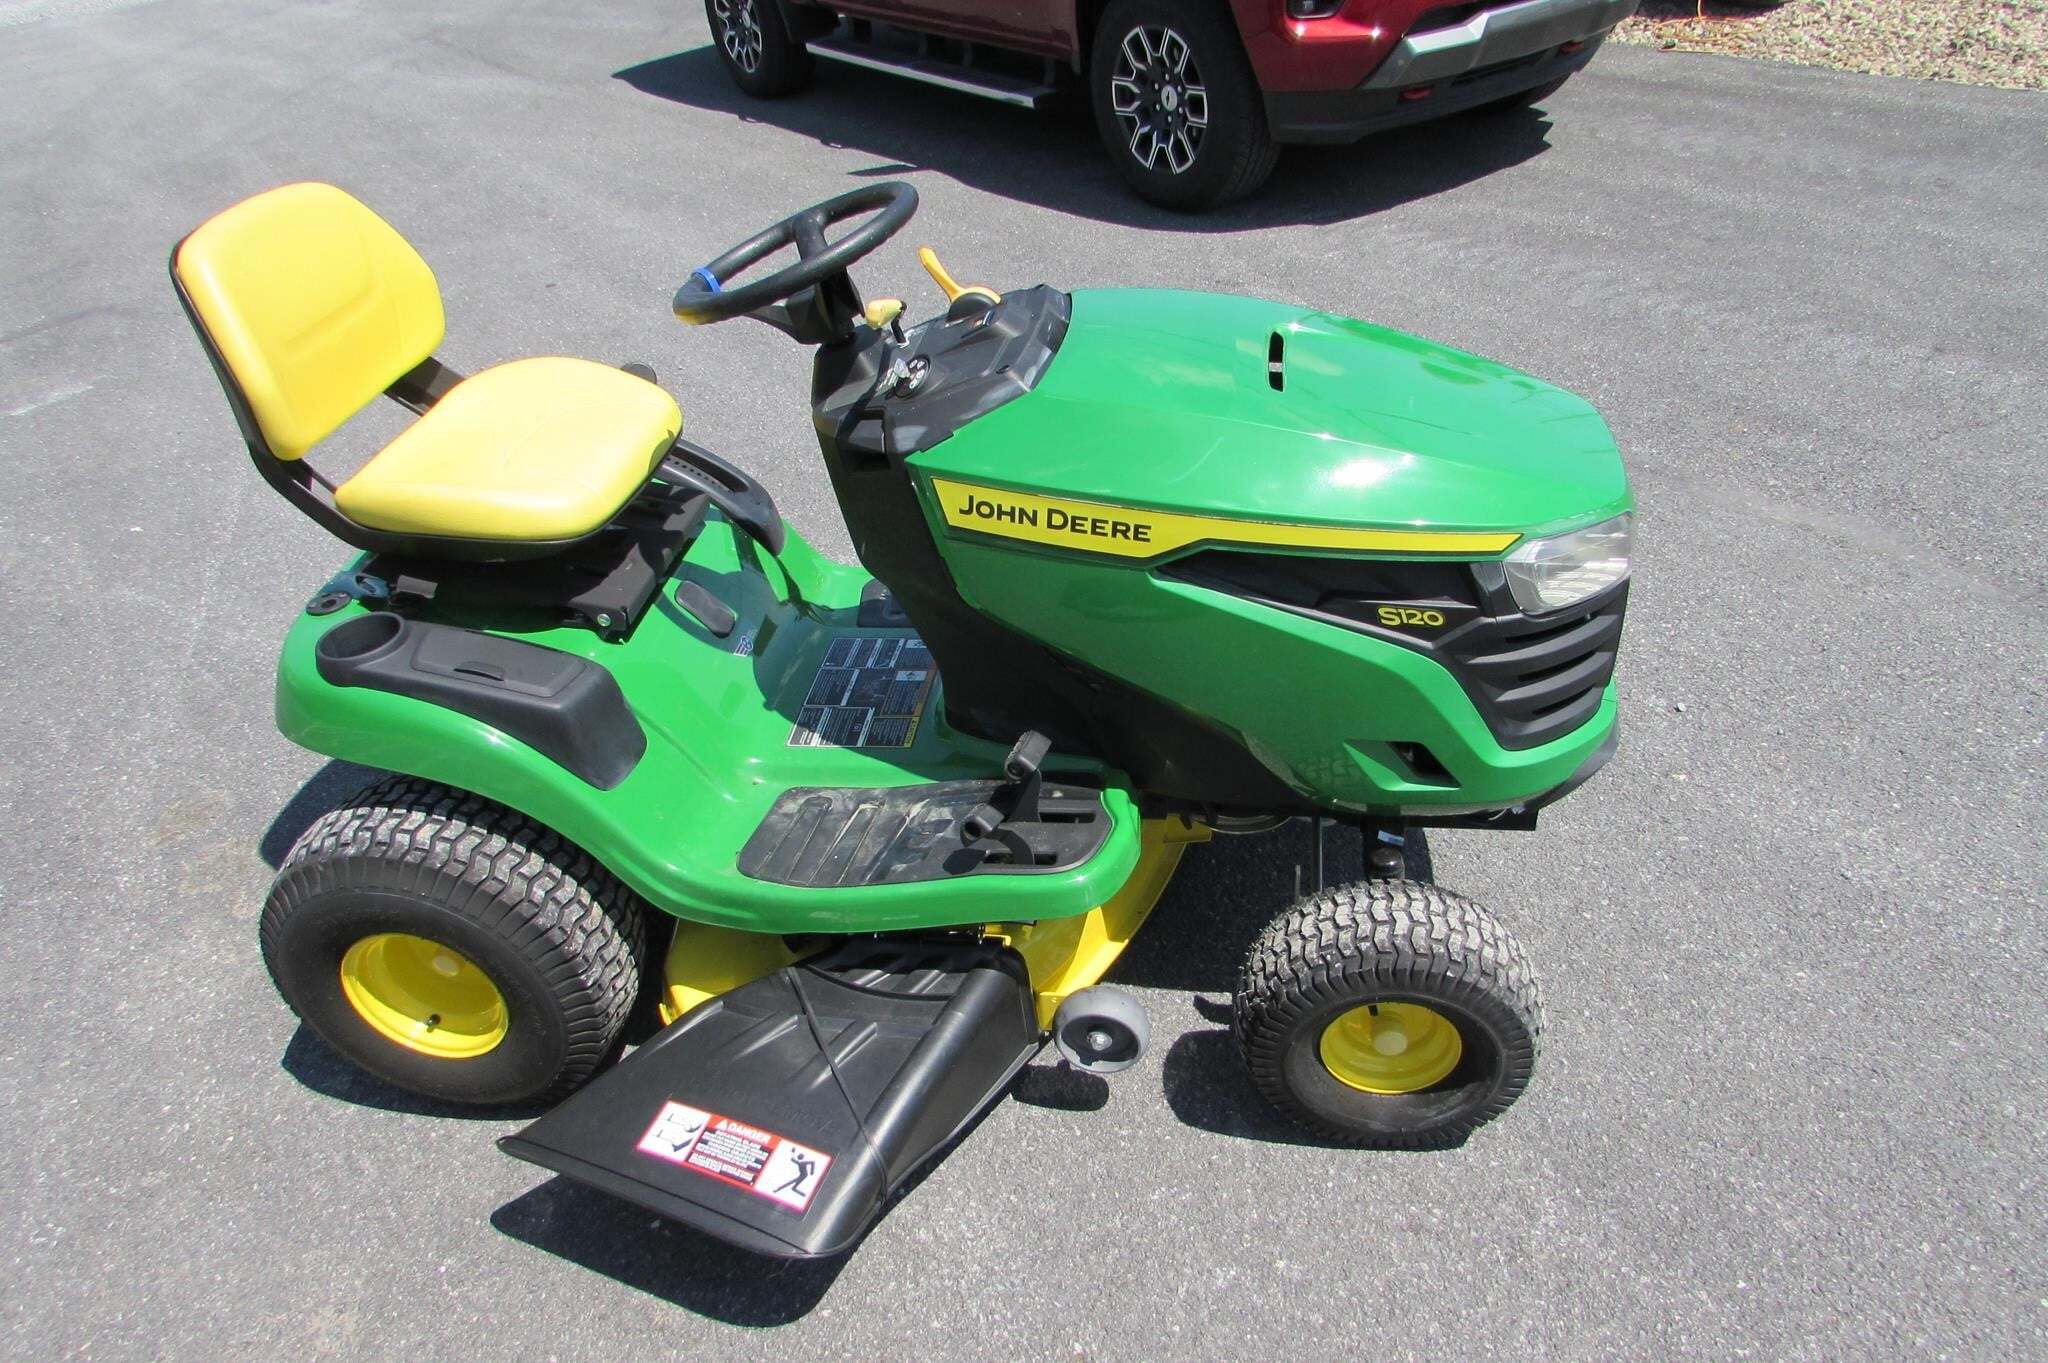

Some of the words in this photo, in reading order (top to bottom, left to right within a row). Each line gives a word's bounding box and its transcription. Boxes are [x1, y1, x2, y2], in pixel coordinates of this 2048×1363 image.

[959, 495, 1038, 527] JOHN
[1046, 508, 1152, 543] DEERE
[1378, 607, 1444, 626] S120
